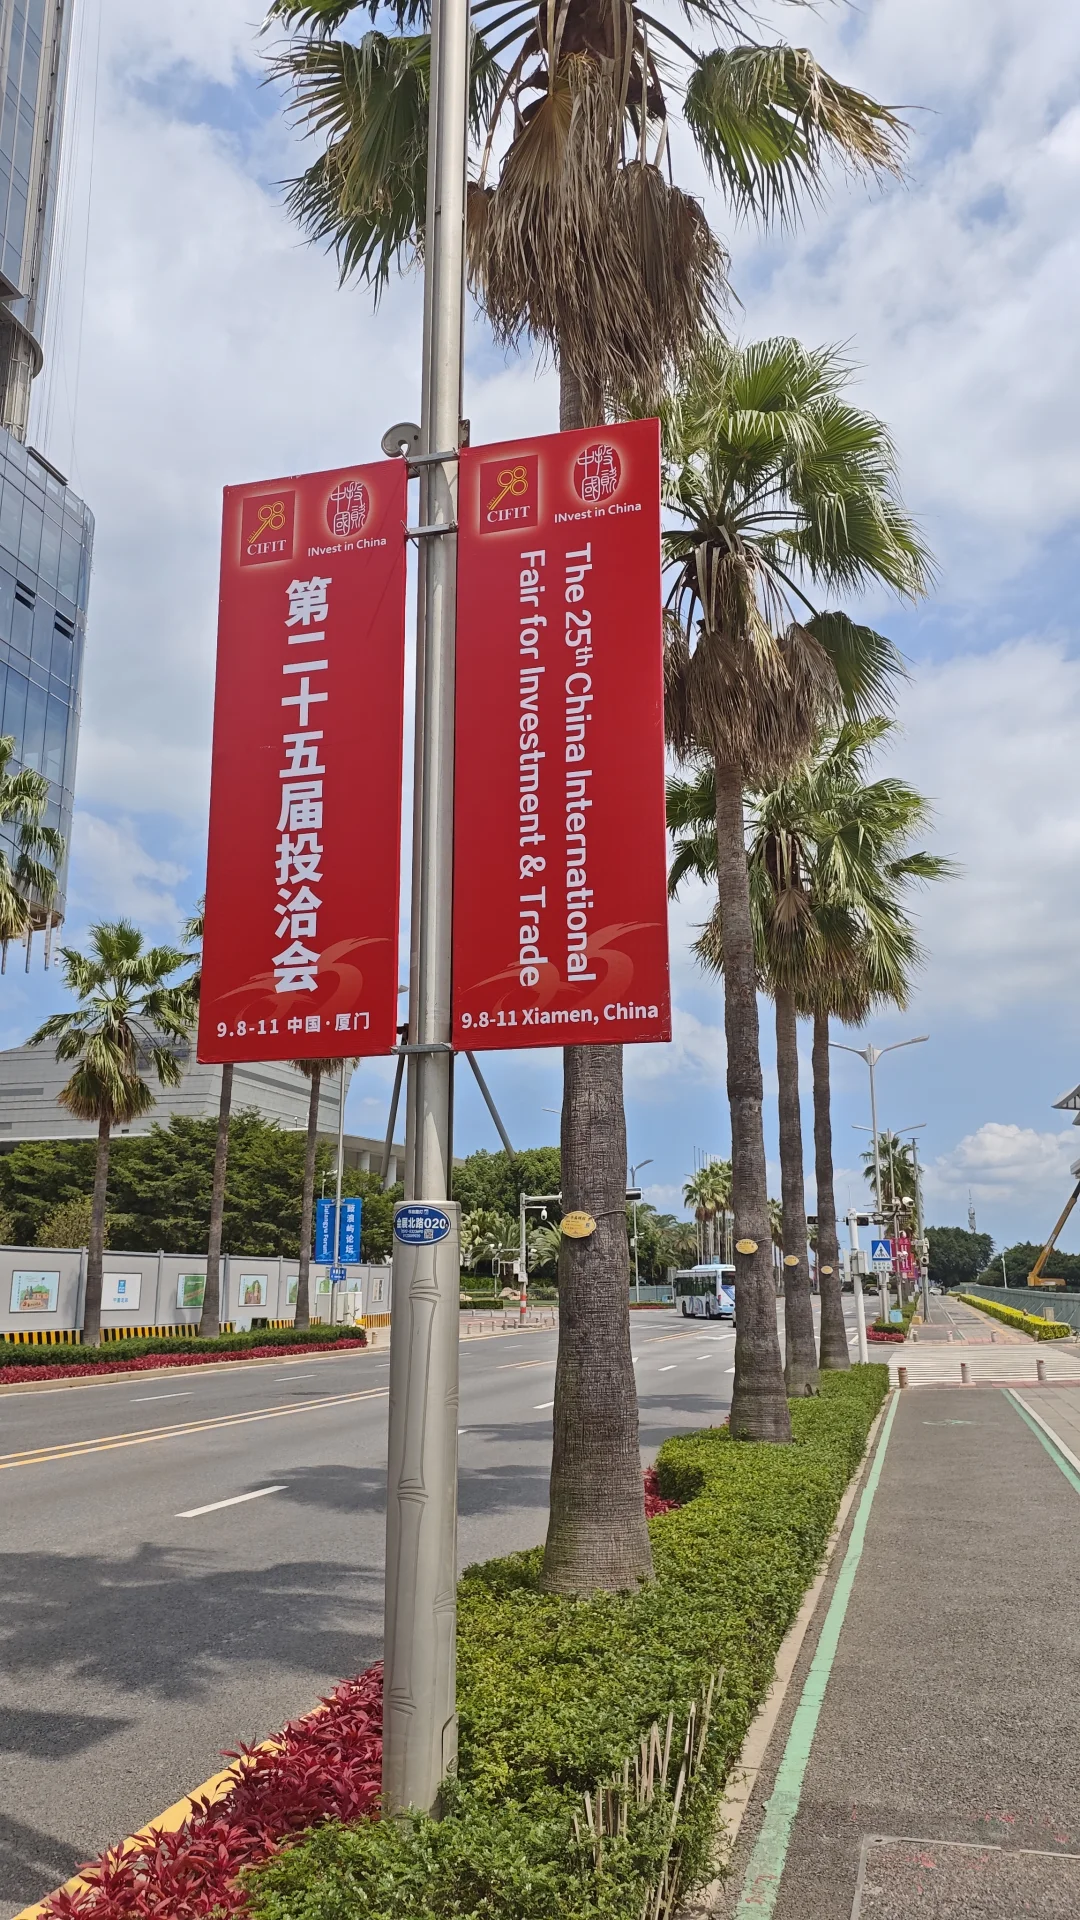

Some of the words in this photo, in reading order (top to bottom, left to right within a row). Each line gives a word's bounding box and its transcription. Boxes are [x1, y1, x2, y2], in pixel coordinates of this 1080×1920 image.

[487, 505, 530, 523] CIFIT
[554, 508, 591, 523] INvest
[594, 507, 605, 517] in
[608, 502, 642, 515] China
[247, 539, 286, 555] CIFIT
[307, 545, 341, 557] INvest
[344, 541, 353, 551] in
[356, 538, 387, 549] China
[565, 542, 593, 603] The
[519, 549, 546, 608] Fair
[519, 614, 547, 660] for
[565, 609, 594, 667] 25th
[565, 672, 594, 763] China
[519, 666, 546, 847] Investment
[271, 576, 332, 994] 第二十五届投洽会
[519, 854, 546, 880] &
[565, 769, 597, 982] International
[519, 886, 548, 987] Trade
[216, 1018, 279, 1038] 9.8-11
[461, 1010, 518, 1029] 9.8-11
[522, 1007, 599, 1026] Xiamen,
[603, 1002, 659, 1021] China
